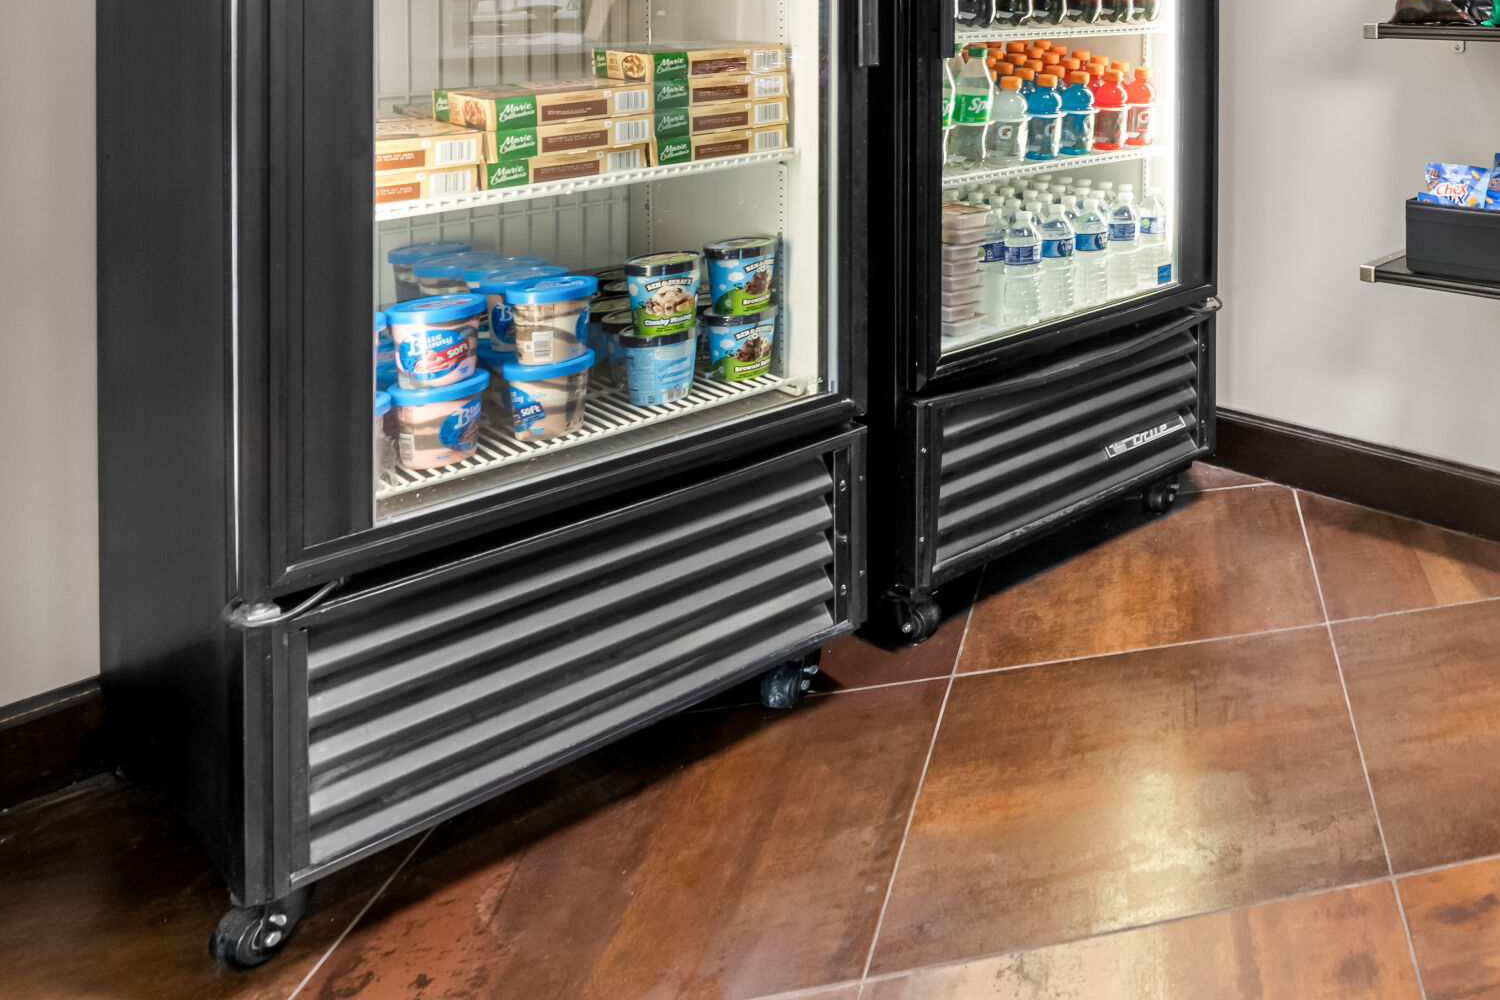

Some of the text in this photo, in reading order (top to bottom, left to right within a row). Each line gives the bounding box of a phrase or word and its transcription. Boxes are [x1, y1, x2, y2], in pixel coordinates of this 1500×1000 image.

[660, 57, 684, 66] Marie
[504, 103, 532, 114] Marie
[504, 134, 533, 146] Marie
[663, 144, 687, 154] Marie
[496, 165, 524, 176] Marie
[1437, 183, 1467, 196] Chex
